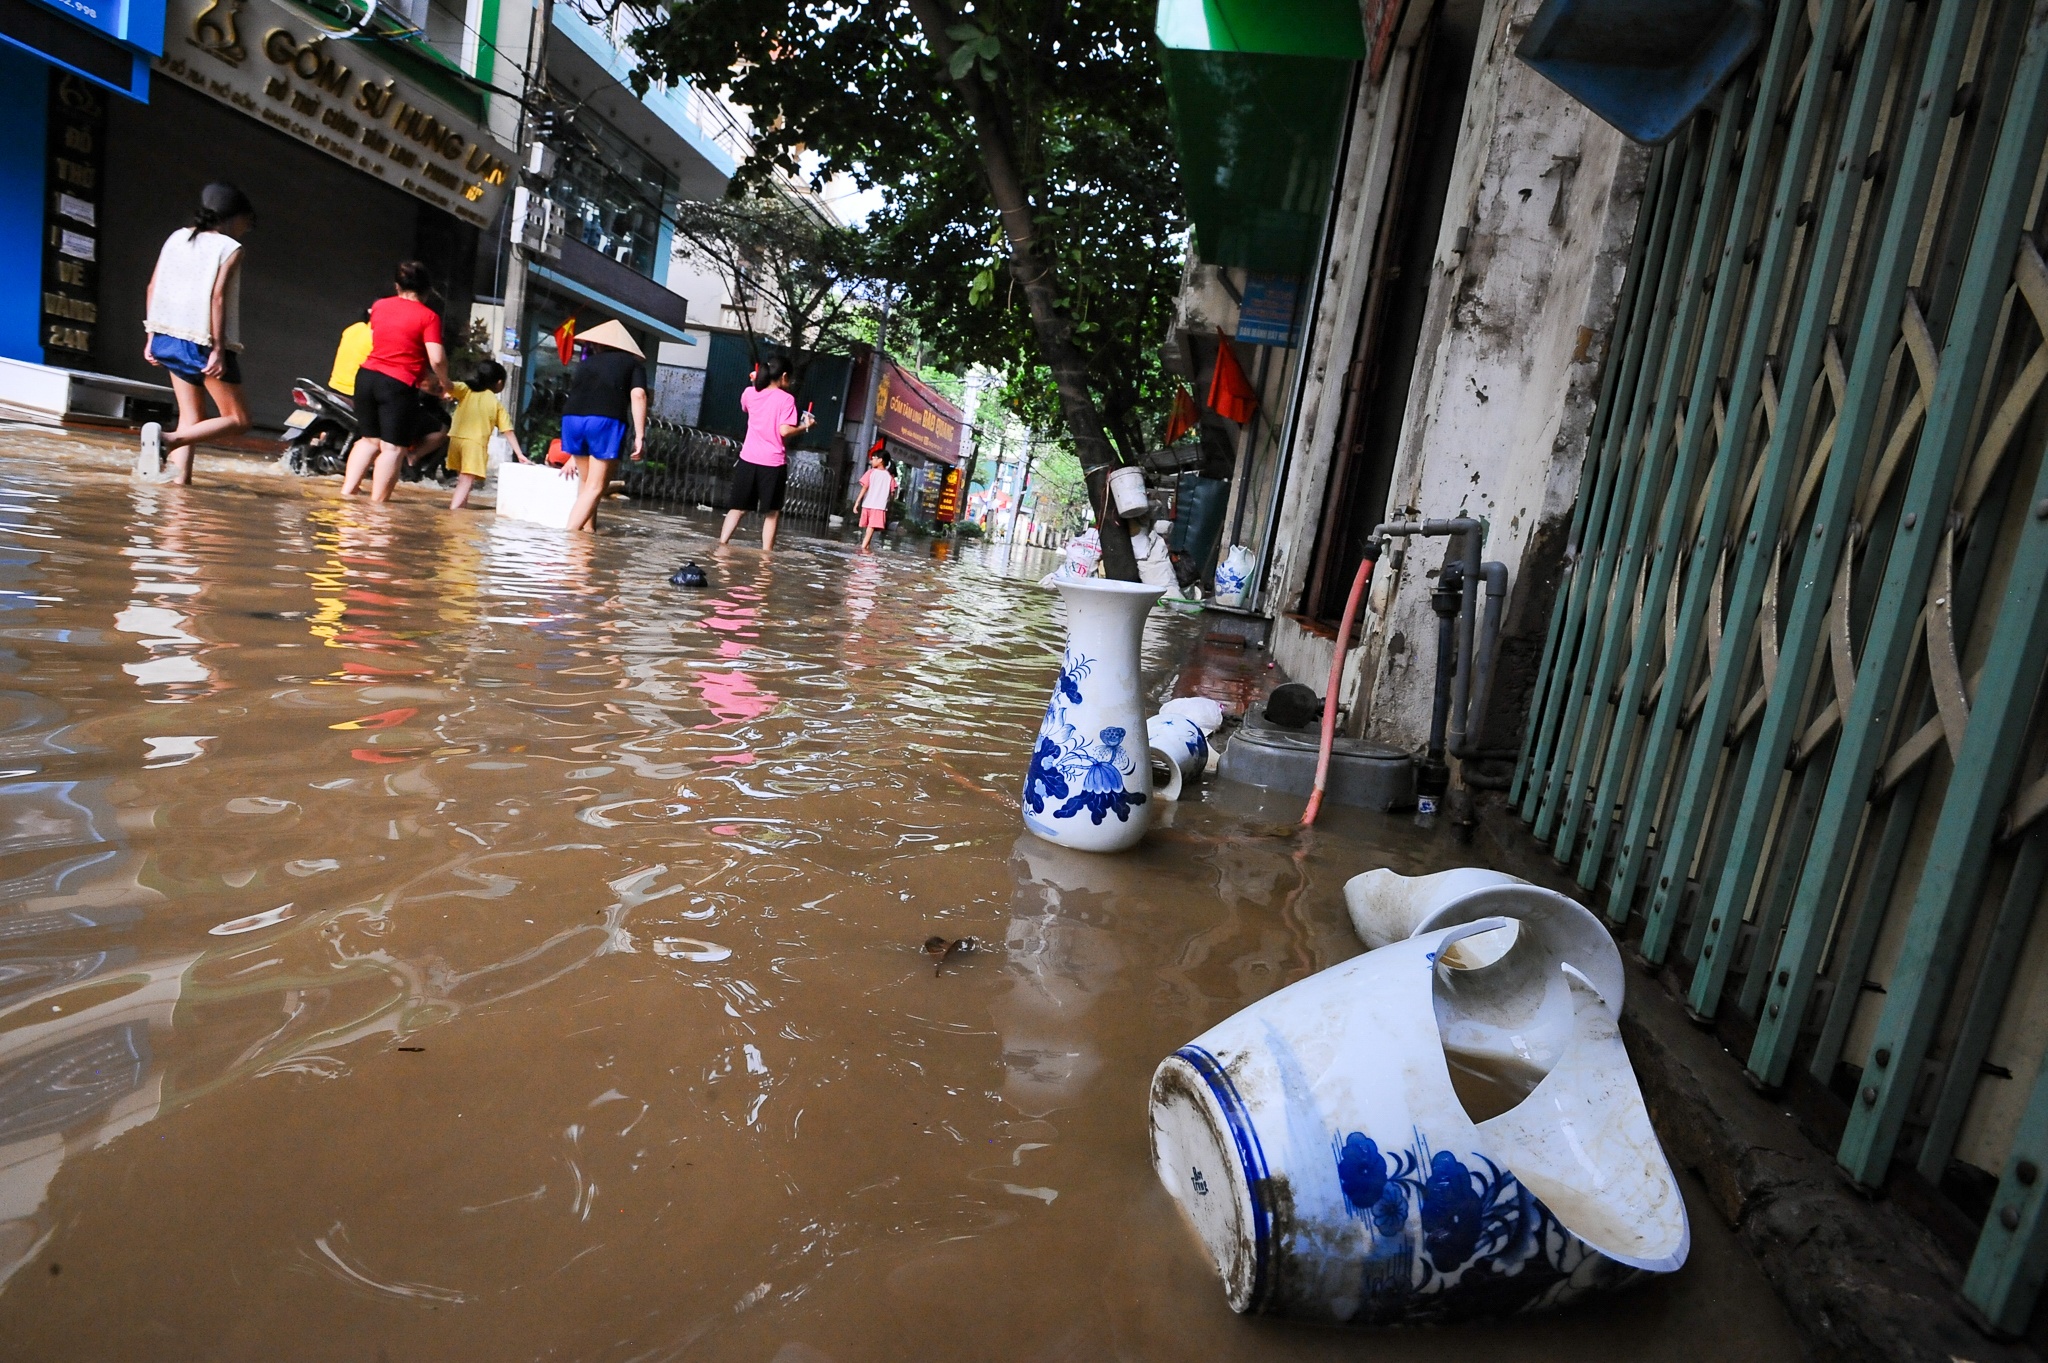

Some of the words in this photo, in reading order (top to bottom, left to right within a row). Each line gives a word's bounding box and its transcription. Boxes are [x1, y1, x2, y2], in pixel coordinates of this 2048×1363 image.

[262, 27, 351, 98] GỐM
[355, 79, 395, 119] SỨ
[465, 144, 510, 185] LAN
